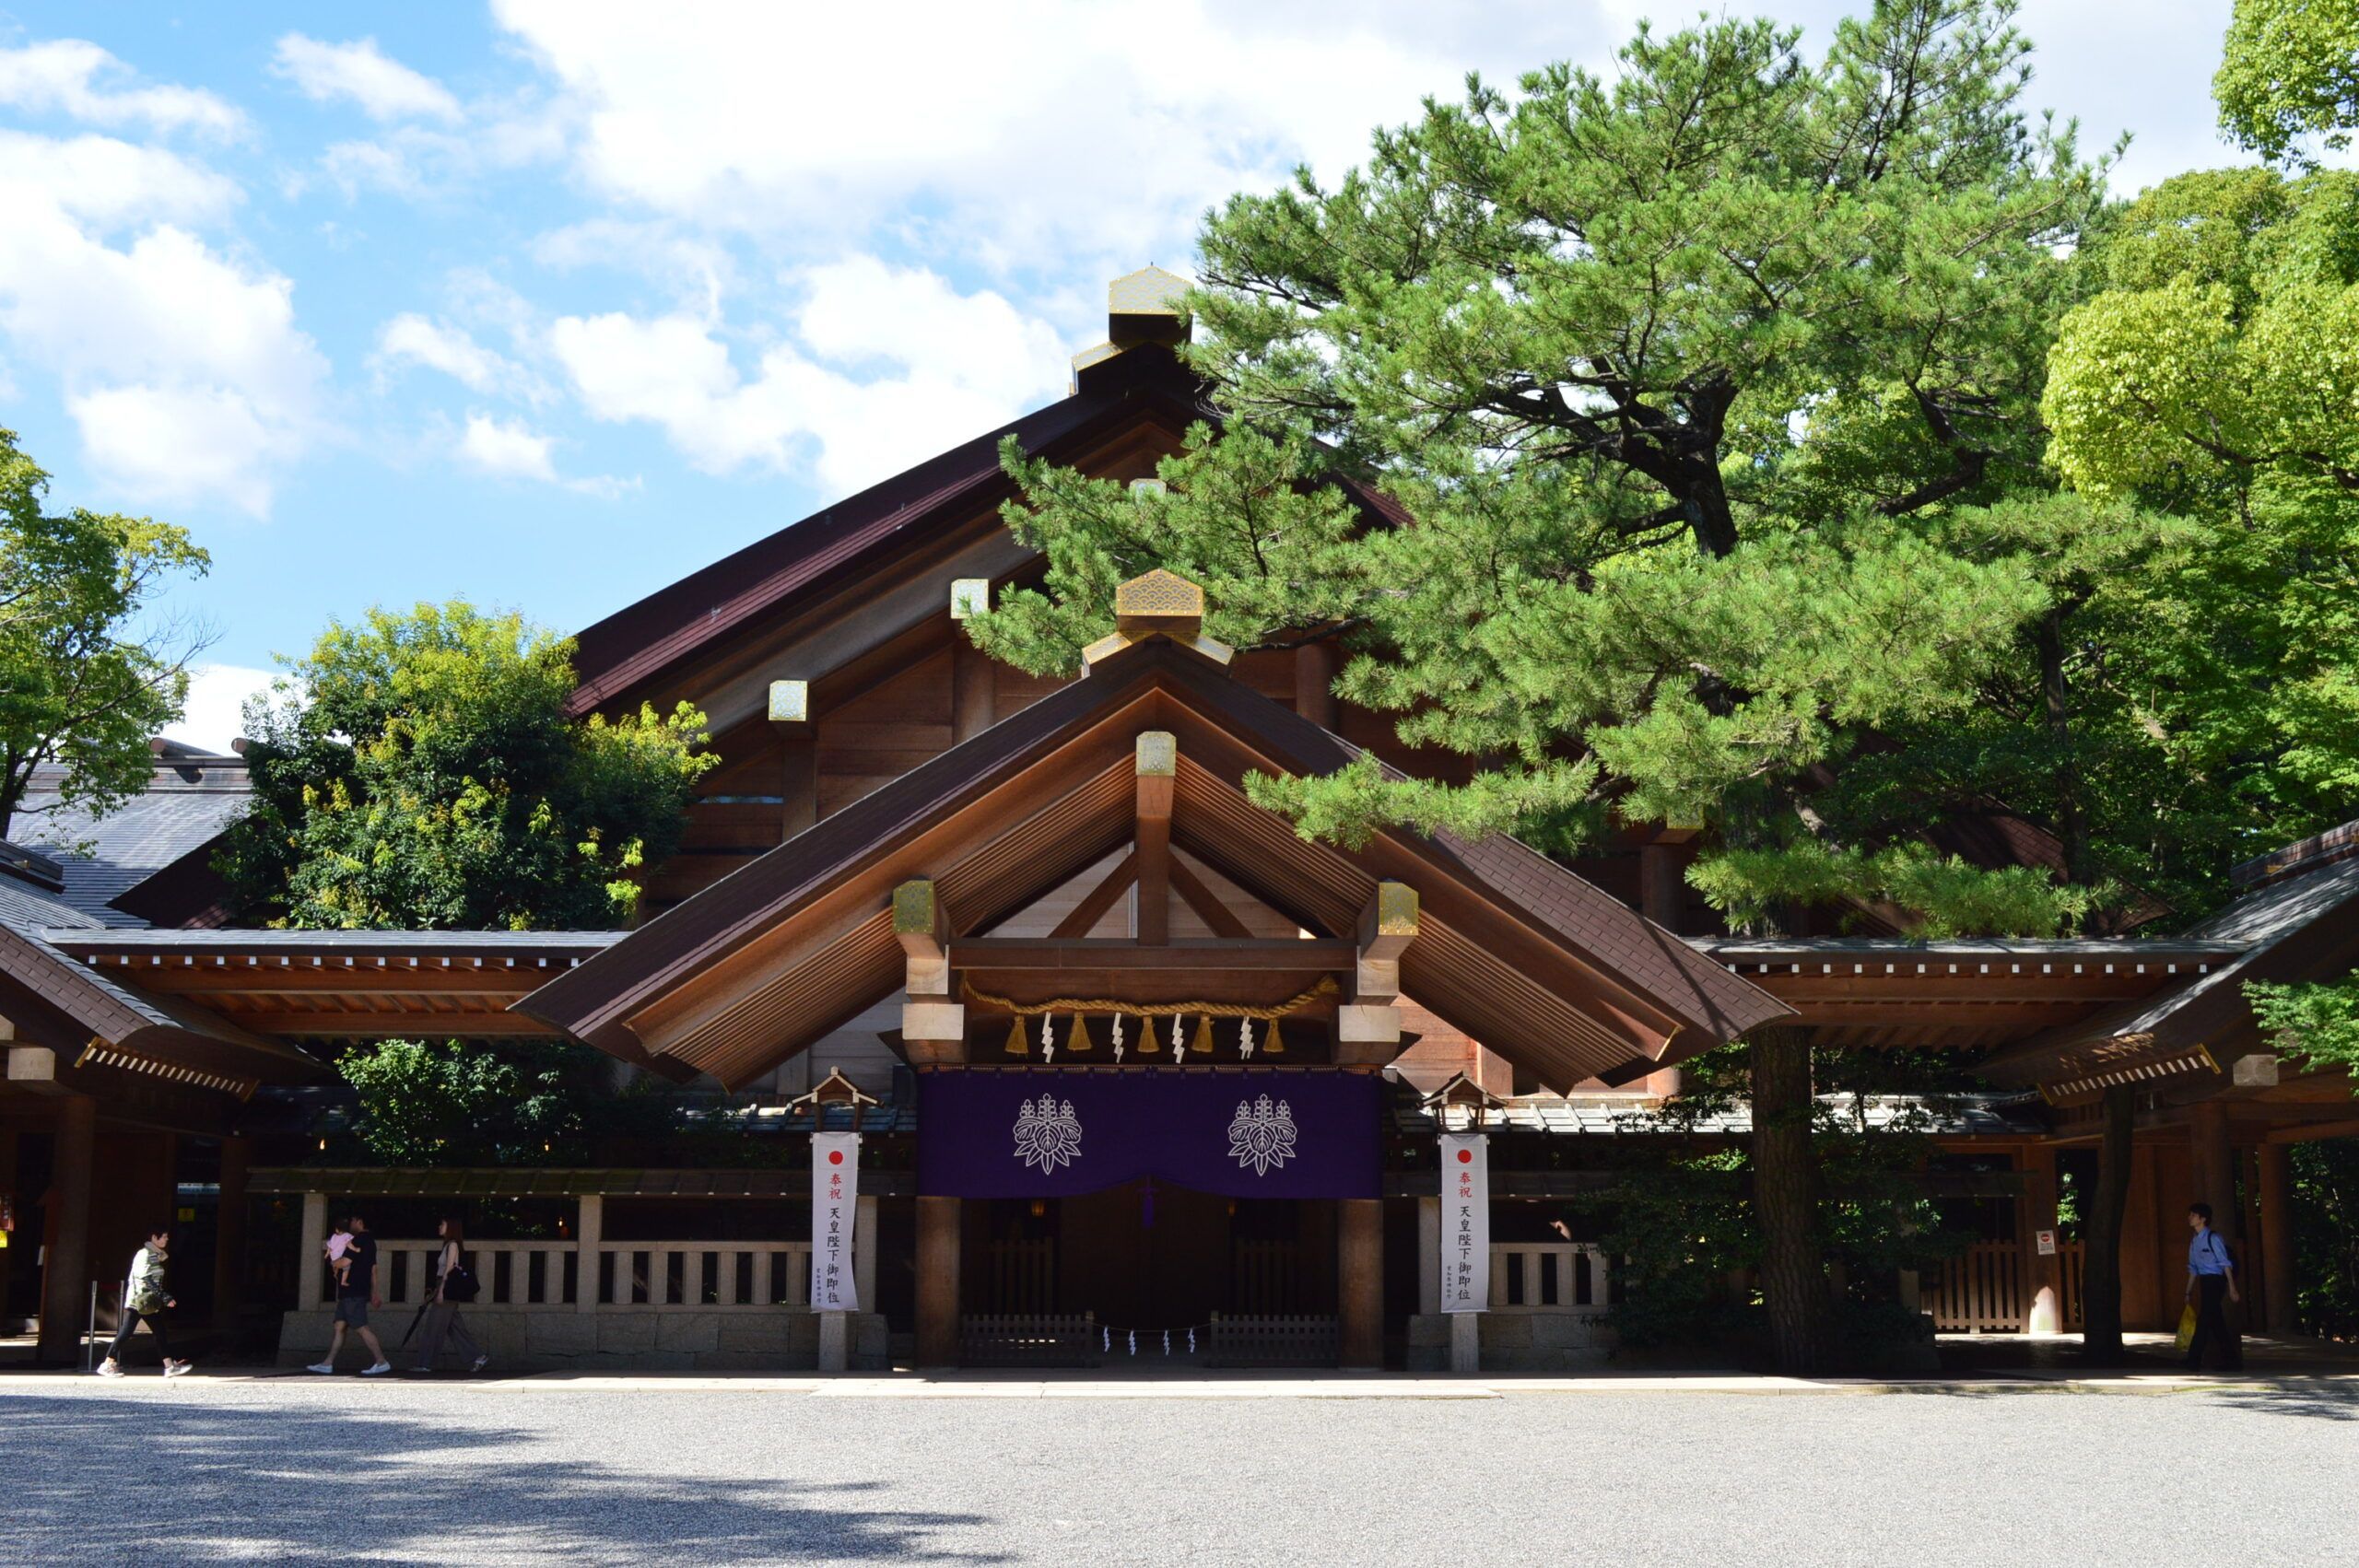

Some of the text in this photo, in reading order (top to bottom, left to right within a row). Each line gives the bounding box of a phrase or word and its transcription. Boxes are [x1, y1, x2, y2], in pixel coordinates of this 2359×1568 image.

[827, 1172, 842, 1304] 奉祝 天皇陛下御即位
[1458, 1171, 1473, 1301] 奉祝 天皇陛下御即位
